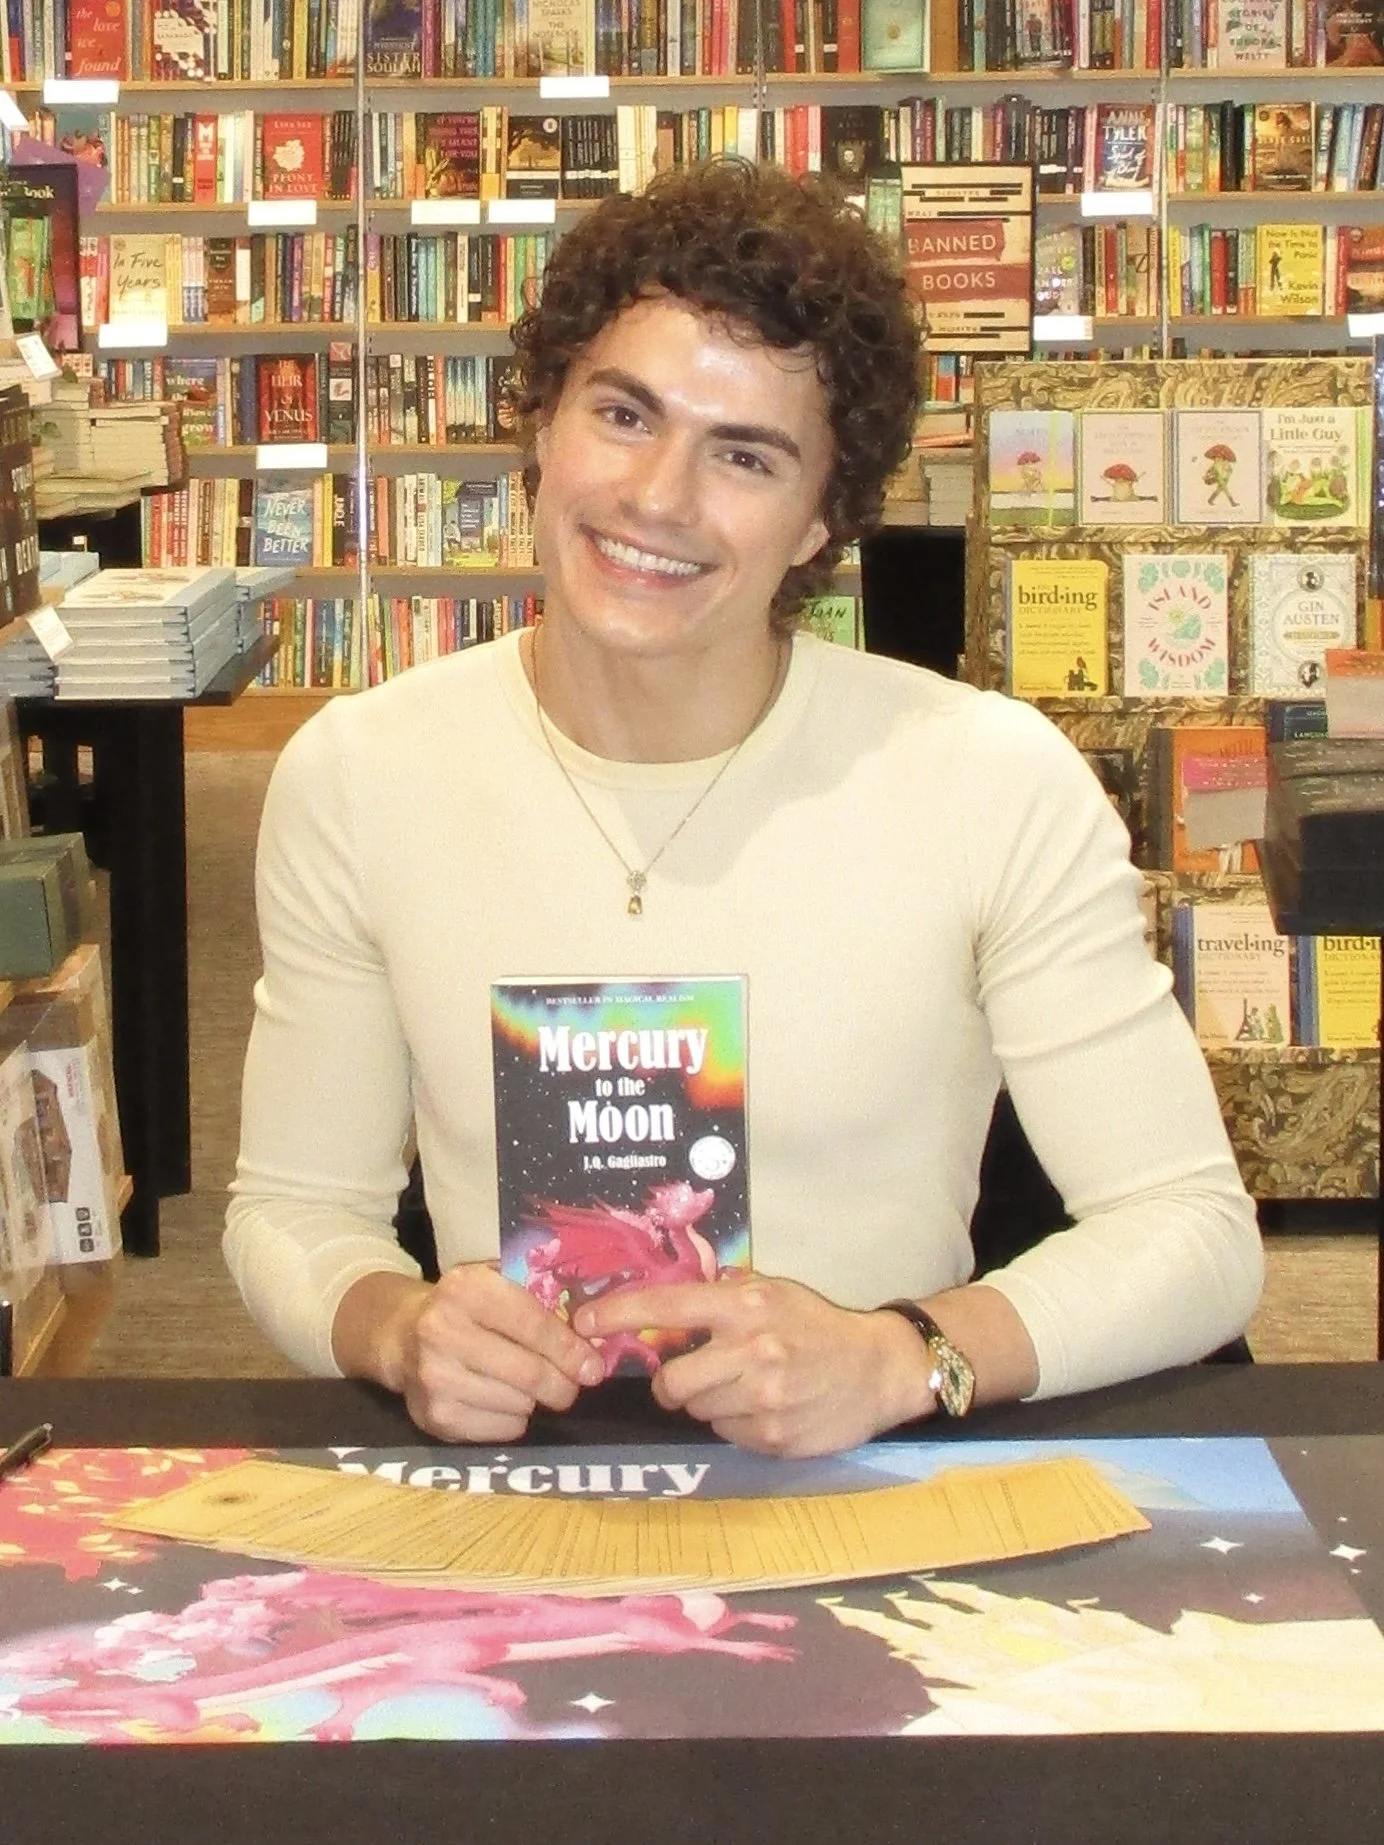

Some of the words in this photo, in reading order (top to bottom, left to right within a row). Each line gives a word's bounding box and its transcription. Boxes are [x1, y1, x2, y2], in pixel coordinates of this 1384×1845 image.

[75, 8, 92, 19] the
[93, 18, 121, 32] love
[77, 37, 97, 48] we
[367, 52, 420, 63] SISTER
[1234, 52, 1269, 60] WELTY
[77, 56, 122, 75] found
[366, 62, 421, 73] SOULJAH
[1103, 125, 1147, 141] TYLER
[272, 173, 313, 182] PEONY
[269, 184, 284, 193] IN
[287, 184, 319, 193] LOVE
[1266, 230, 1288, 238] Now
[1290, 230, 1298, 238] Is
[1300, 230, 1318, 238] Not
[908, 234, 996, 254] BANNED
[1285, 240, 1306, 249] Time
[1308, 240, 1318, 248] to
[113, 253, 125, 269] In
[130, 251, 164, 269] Five
[1293, 251, 1318, 259] Panic
[922, 271, 996, 290] BOOKS
[1288, 281, 1318, 290] Kevin
[116, 275, 161, 302] Years
[1280, 294, 1318, 304] Wilson
[166, 375, 204, 386] where
[271, 375, 303, 387] HEIR
[264, 409, 313, 422] VENUS
[1277, 414, 1296, 424] I'm
[1299, 414, 1325, 424] Just
[1327, 416, 1336, 424] a
[181, 423, 213, 437] grow
[1269, 428, 1307, 440] Little
[1312, 428, 1342, 442] Guy
[262, 499, 306, 519] NEVER
[267, 519, 302, 537] BEEN
[263, 538, 308, 554] BETTER
[1147, 585, 1212, 611] ISLAND
[1299, 601, 1325, 612] GIN
[1283, 613, 1341, 626] AUSTEN
[1147, 637, 1216, 667] WISDOM
[1293, 731, 1329, 739] LANGUA
[537, 1025, 709, 1074] Mercury
[595, 1078, 613, 1097] to
[617, 1077, 645, 1097] the
[568, 1100, 675, 1143] Moon
[607, 1155, 667, 1170] Gagliastro
[335, 1460, 711, 1496] Mercury
